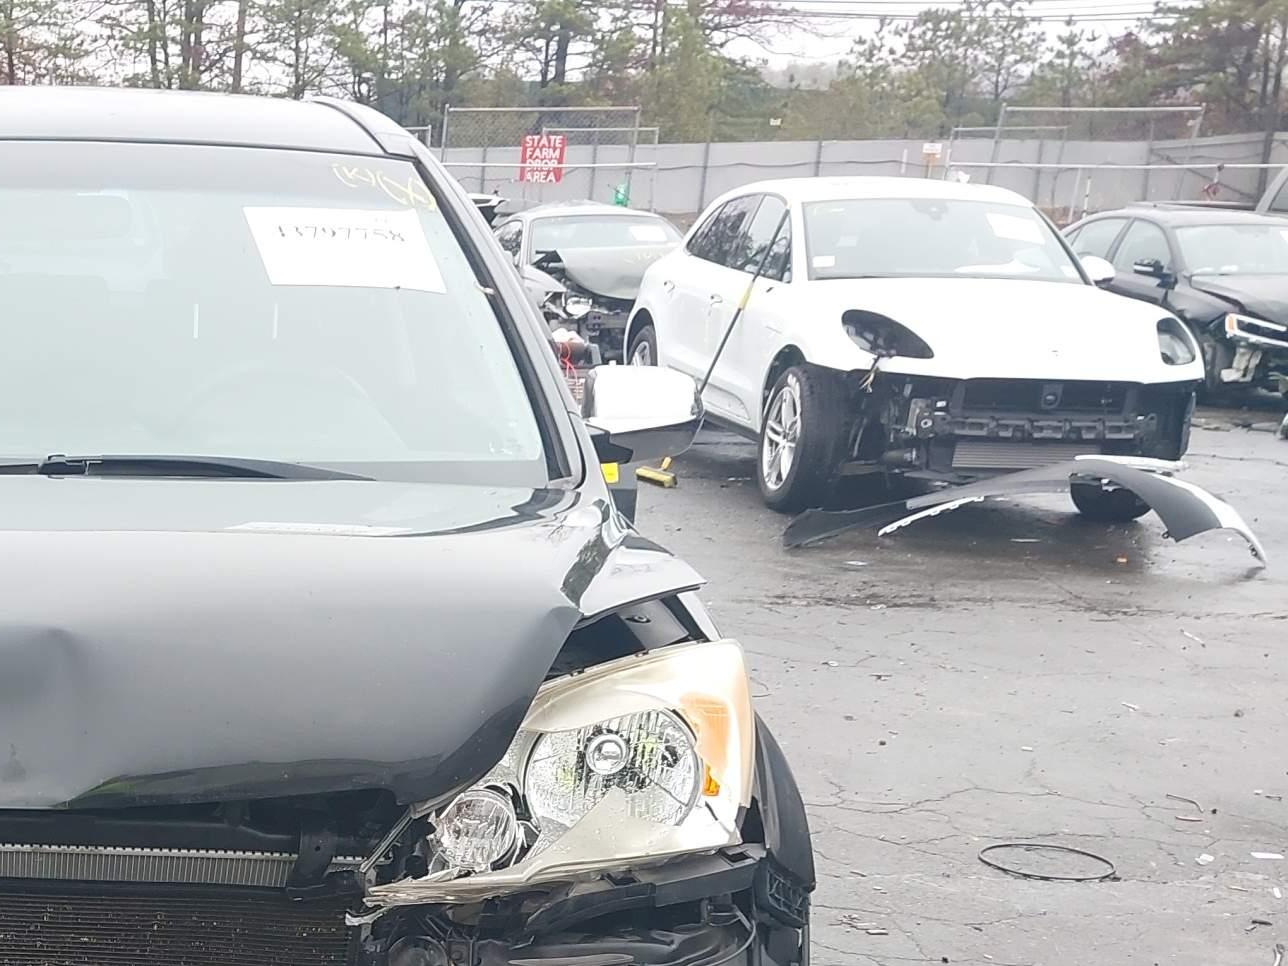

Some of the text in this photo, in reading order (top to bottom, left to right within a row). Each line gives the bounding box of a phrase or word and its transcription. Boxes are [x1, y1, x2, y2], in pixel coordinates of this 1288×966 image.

[525, 135, 563, 148] STATE
[526, 147, 561, 159] FARM
[526, 171, 557, 183] AREA
